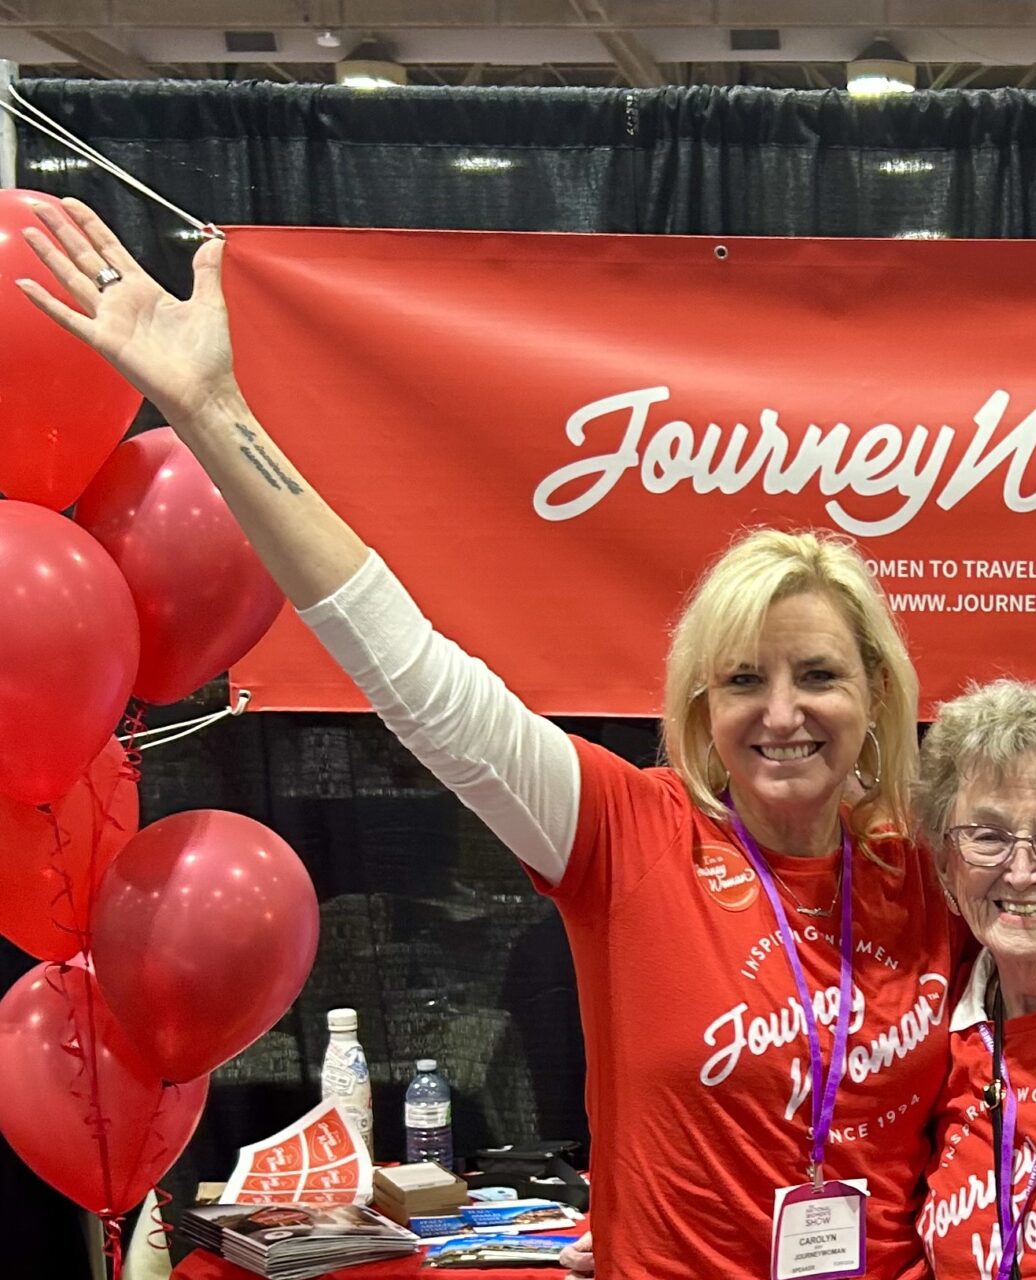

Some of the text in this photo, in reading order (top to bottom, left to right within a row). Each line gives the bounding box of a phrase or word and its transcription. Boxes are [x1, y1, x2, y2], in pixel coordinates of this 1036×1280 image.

[865, 560, 924, 578] OMEN
[929, 560, 958, 578] TO
[805, 1123, 869, 1144] SNCE
[799, 1233, 837, 1246] CAROLYN
